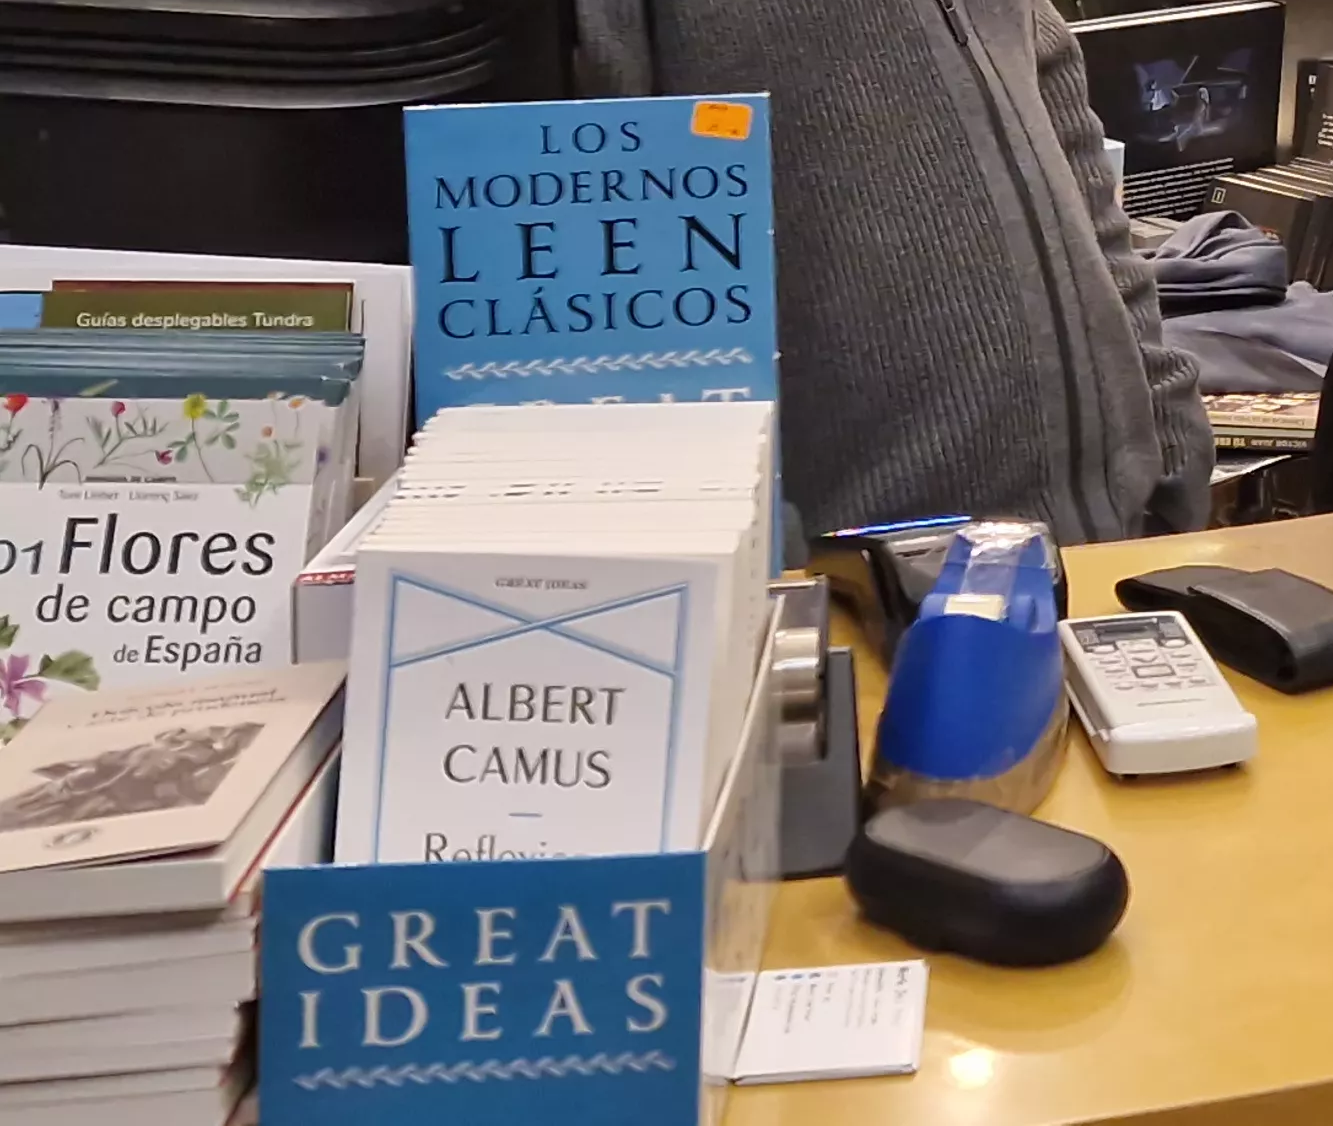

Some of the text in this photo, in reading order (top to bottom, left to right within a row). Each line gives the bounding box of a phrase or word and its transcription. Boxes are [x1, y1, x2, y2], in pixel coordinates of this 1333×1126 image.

[539, 121, 643, 155] LOS
[434, 164, 748, 210] MODERNOS
[438, 212, 747, 284] LEEN
[76, 312, 314, 331] Guías desplegables Tundra
[438, 284, 753, 340] CLÁSICOS
[58, 512, 276, 576] Flores
[36, 583, 257, 634] de campo
[113, 635, 263, 672] de España
[444, 682, 627, 726] ALBERT
[442, 744, 613, 789] CAMUS
[297, 898, 673, 975] GREAT
[298, 973, 671, 1050] IDEAS
